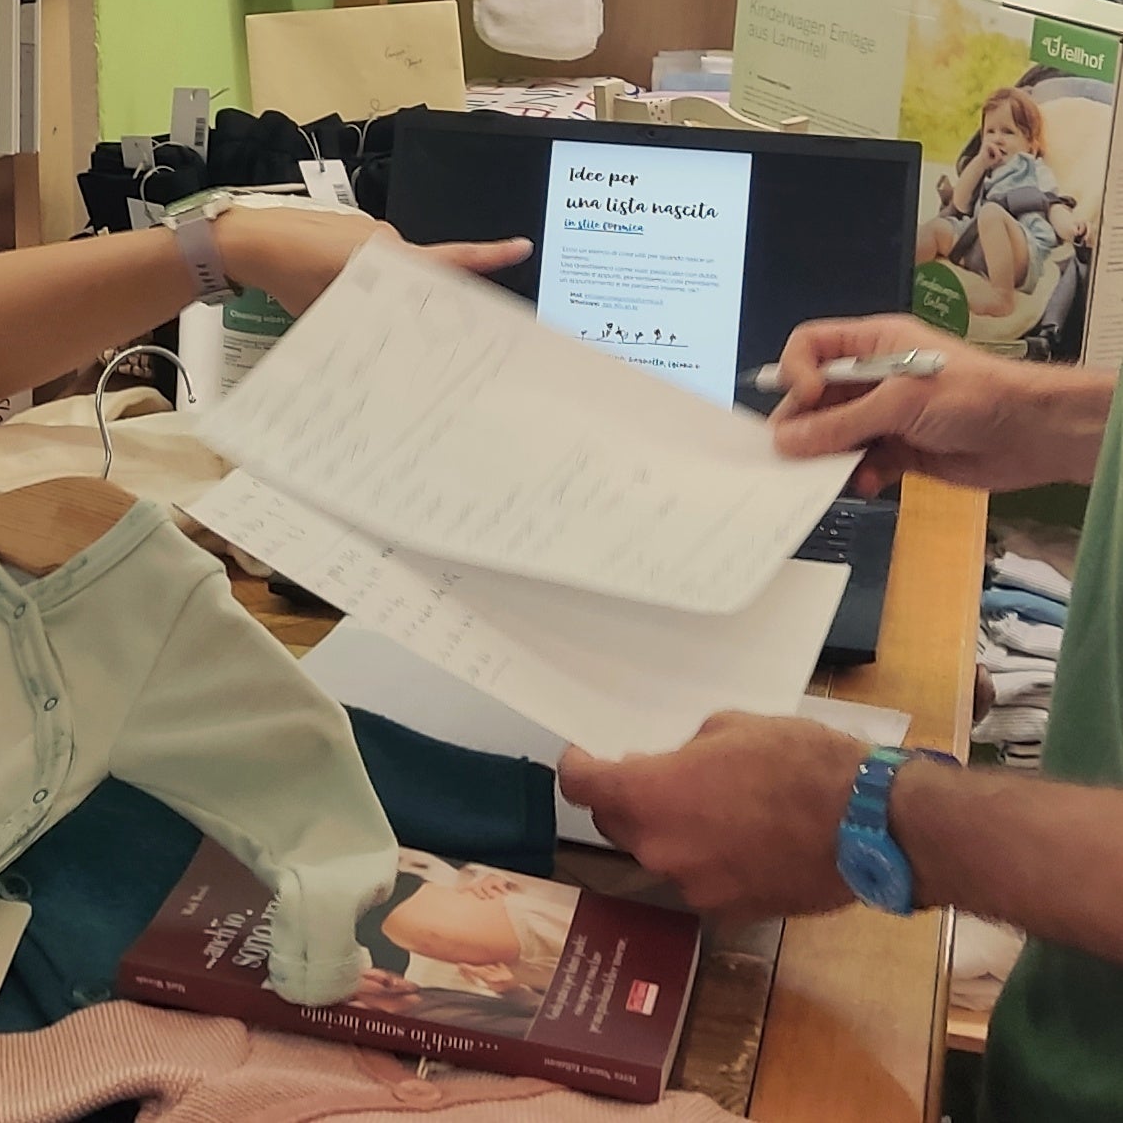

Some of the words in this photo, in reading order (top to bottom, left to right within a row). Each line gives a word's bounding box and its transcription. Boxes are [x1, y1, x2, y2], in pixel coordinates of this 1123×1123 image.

[748, 23, 768, 42] aus
[829, 22, 877, 55] Einlage
[1060, 42, 1105, 71] fellhof
[569, 166, 605, 182] Idee
[608, 171, 639, 187] per
[566, 196, 602, 210] una
[606, 196, 647, 216] lista
[651, 201, 719, 220] nascita
[564, 218, 576, 227] in
[578, 218, 599, 230] stile
[603, 221, 644, 233] formica
[300, 1006, 359, 1035] incinto
[365, 1019, 406, 1036] sono
